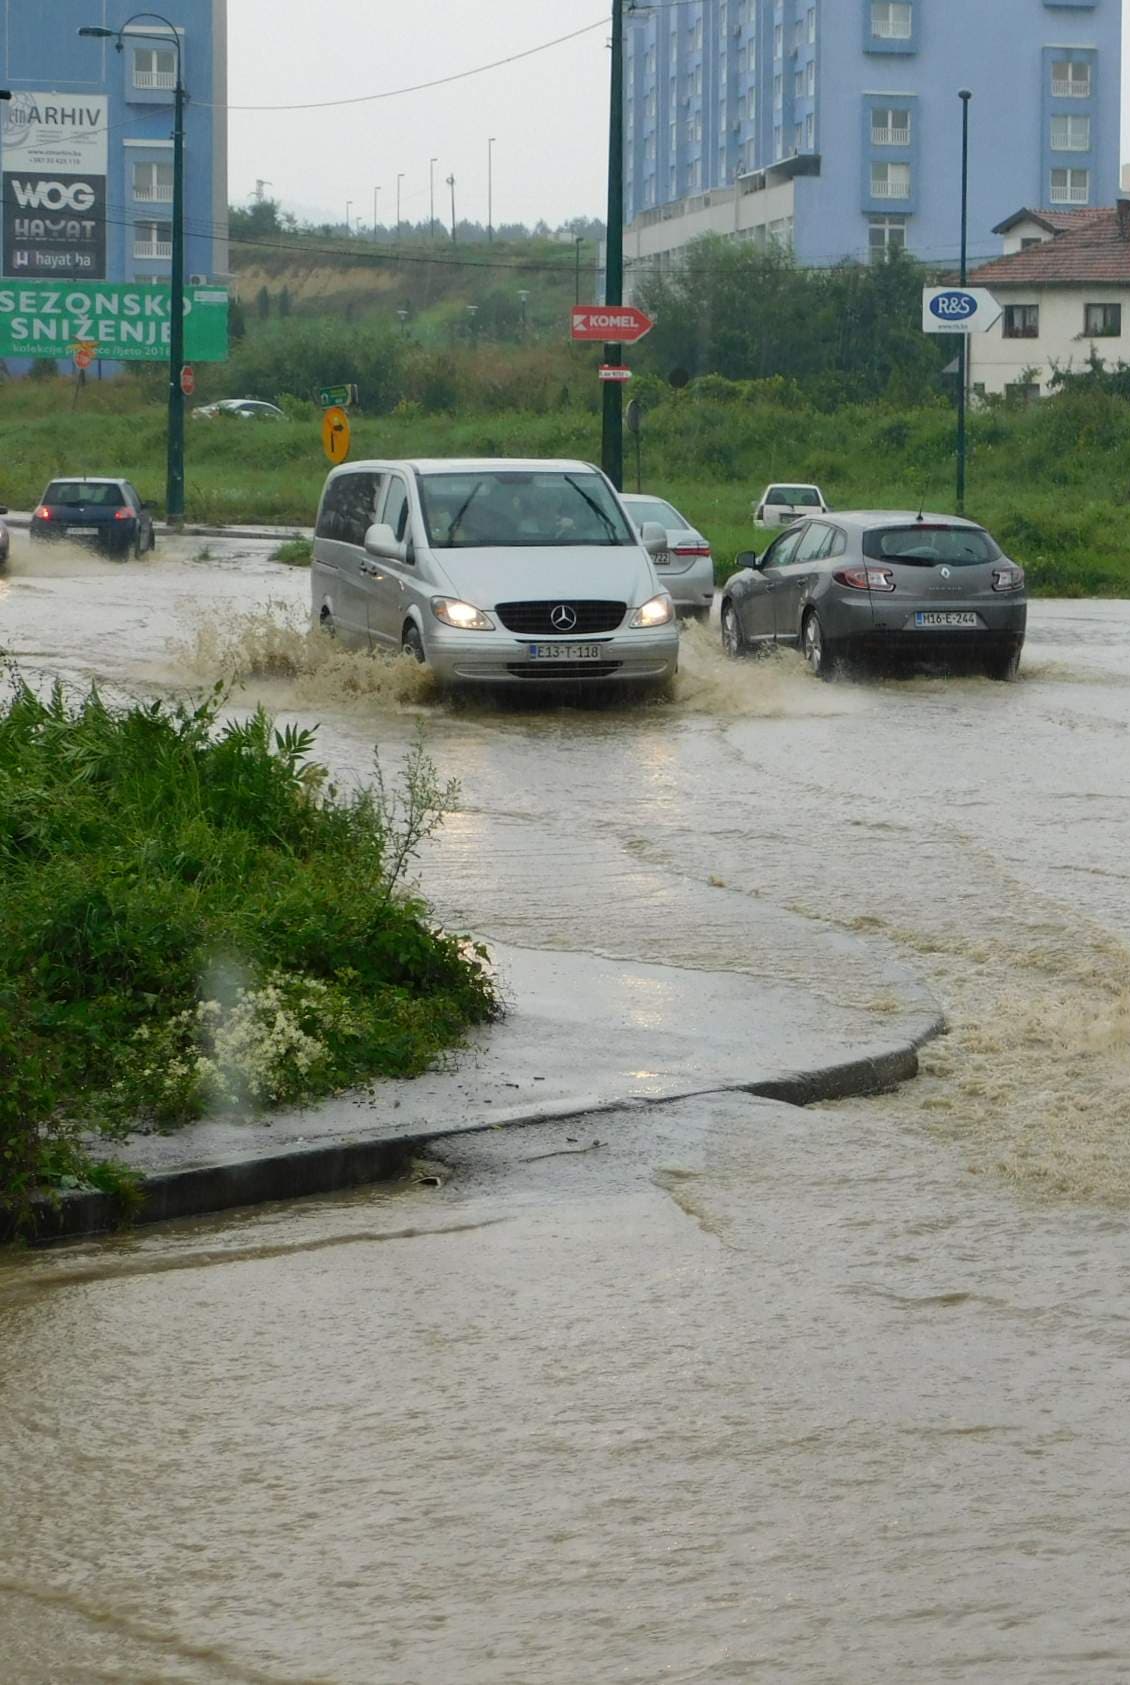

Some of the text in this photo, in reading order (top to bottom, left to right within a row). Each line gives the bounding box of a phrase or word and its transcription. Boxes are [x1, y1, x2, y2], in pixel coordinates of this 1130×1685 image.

[11, 180, 95, 211] WOG
[15, 219, 96, 238] HAYAT
[35, 252, 91, 268] hayatba
[0, 290, 192, 317] SEZONSKO
[938, 296, 970, 314] R&S
[11, 315, 171, 344] SNIŽENJE
[589, 315, 639, 328] KOMEL
[538, 646, 598, 658] E13-T-118
